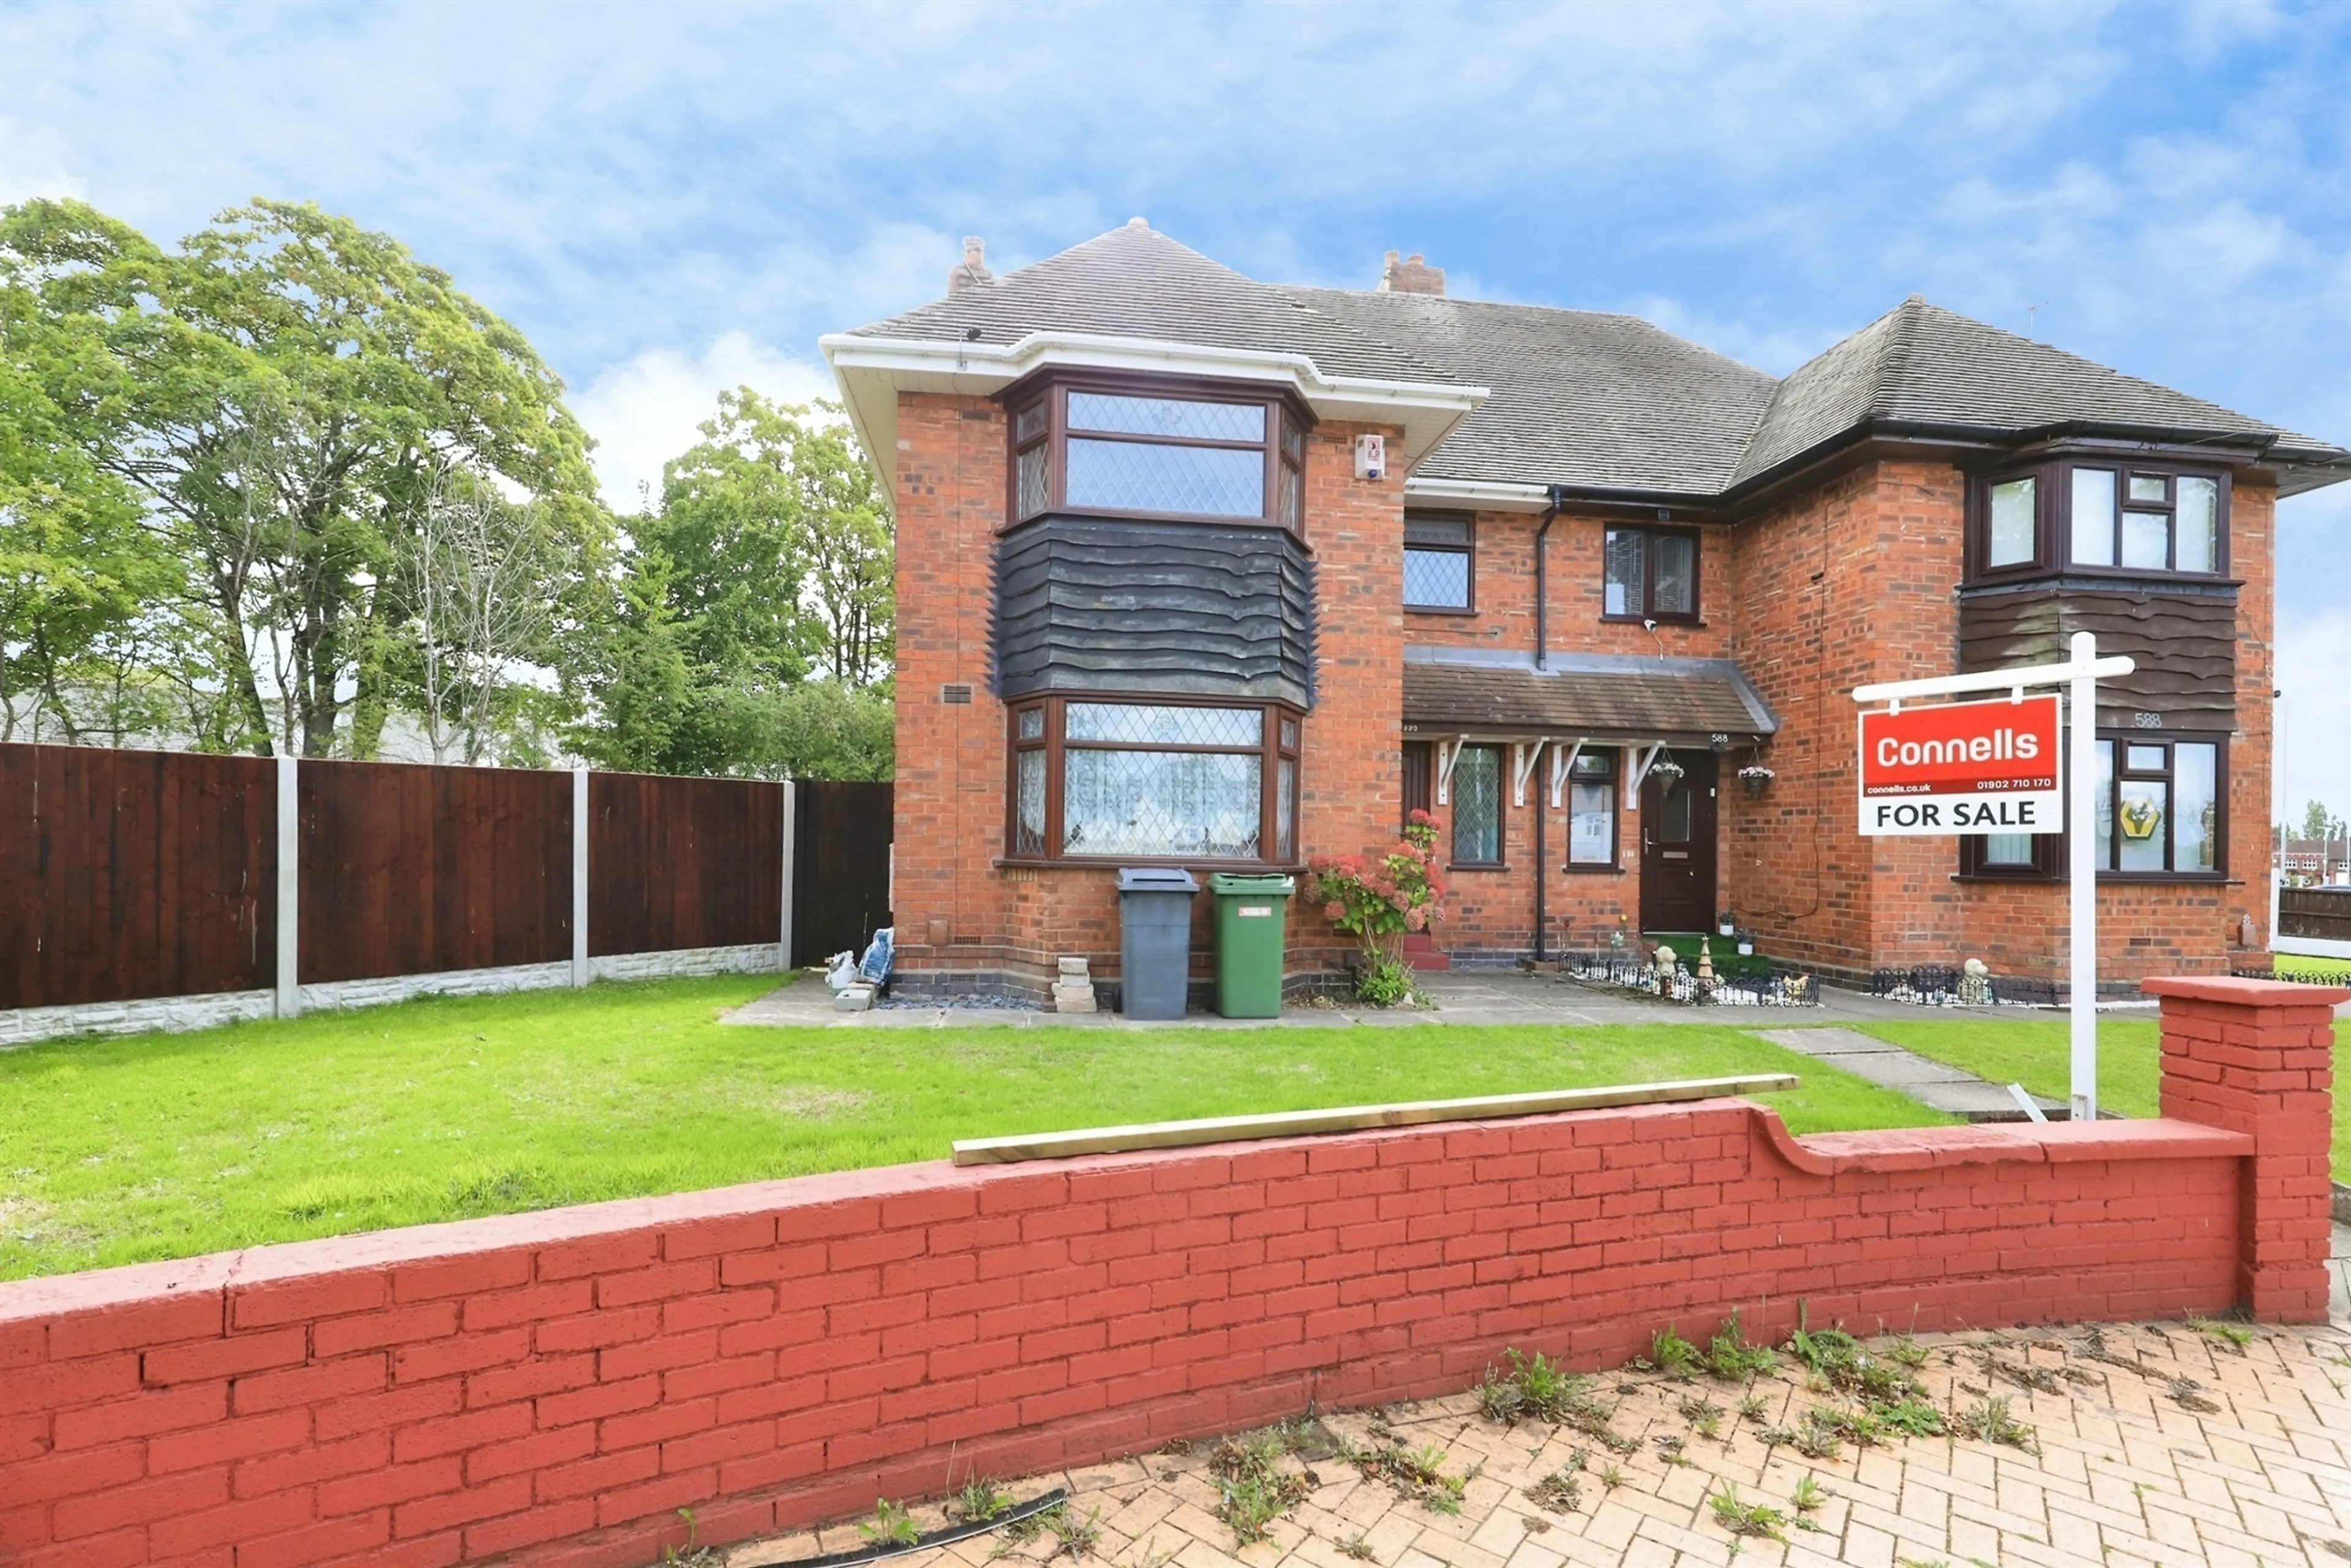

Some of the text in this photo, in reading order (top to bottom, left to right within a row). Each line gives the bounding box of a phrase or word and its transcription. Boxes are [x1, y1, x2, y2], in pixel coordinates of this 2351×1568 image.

[2135, 713, 2162, 728] 588
[1711, 733, 1728, 743] 588
[1877, 727, 2039, 767] Connells
[1867, 783, 1931, 794] connells.co.uk
[1977, 778, 2051, 790] 01902 710 170
[1878, 801, 2036, 827] FOR SALE
